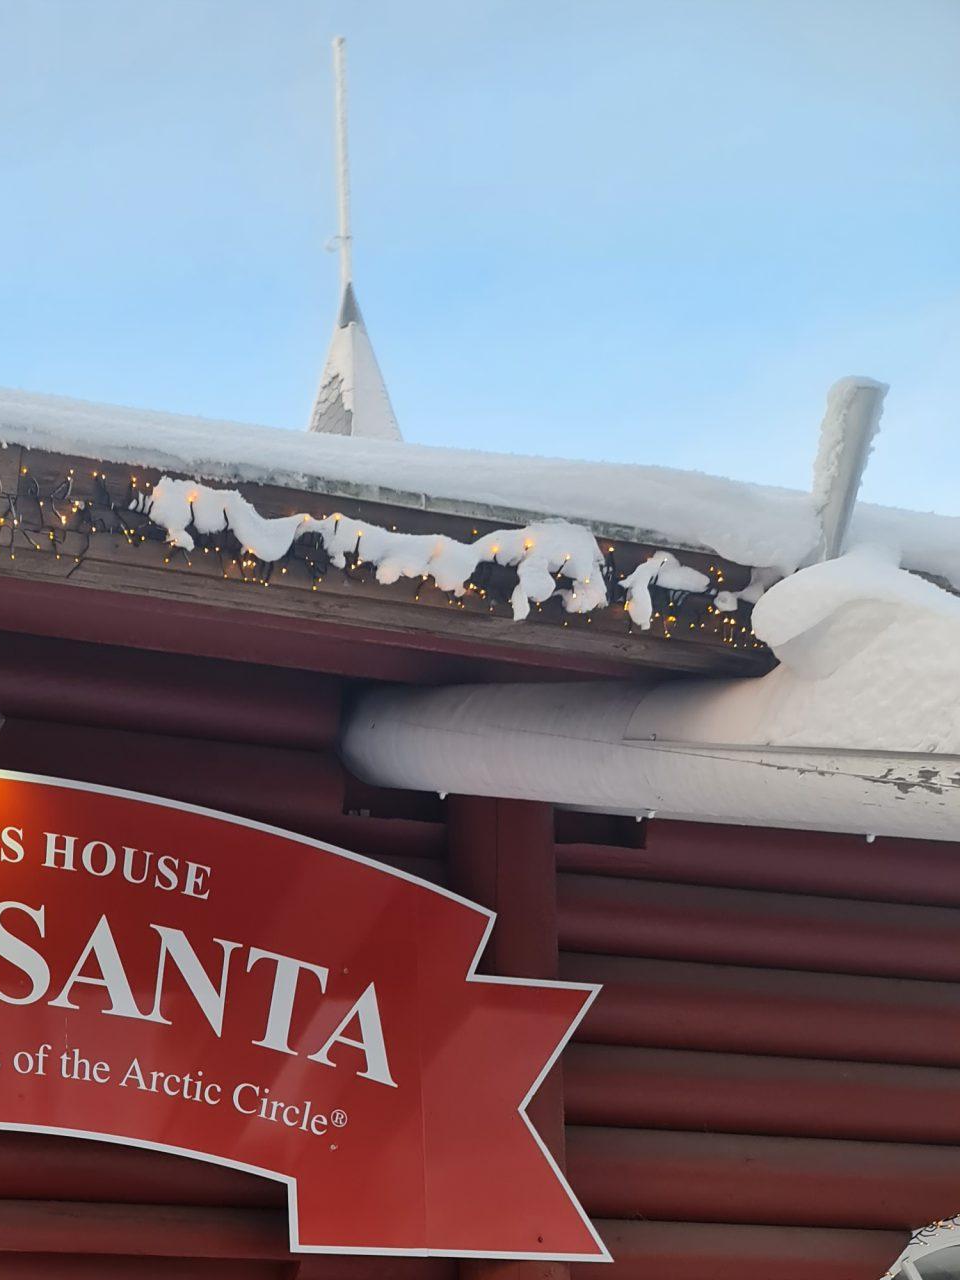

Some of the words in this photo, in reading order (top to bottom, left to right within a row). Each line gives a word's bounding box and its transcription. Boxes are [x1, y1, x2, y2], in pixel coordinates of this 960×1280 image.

[42, 832, 212, 900] HOUSE
[13, 1044, 52, 1076] of
[60, 1049, 111, 1084] the
[119, 1058, 222, 1105] Arctic
[232, 1082, 348, 1136] Circle®
